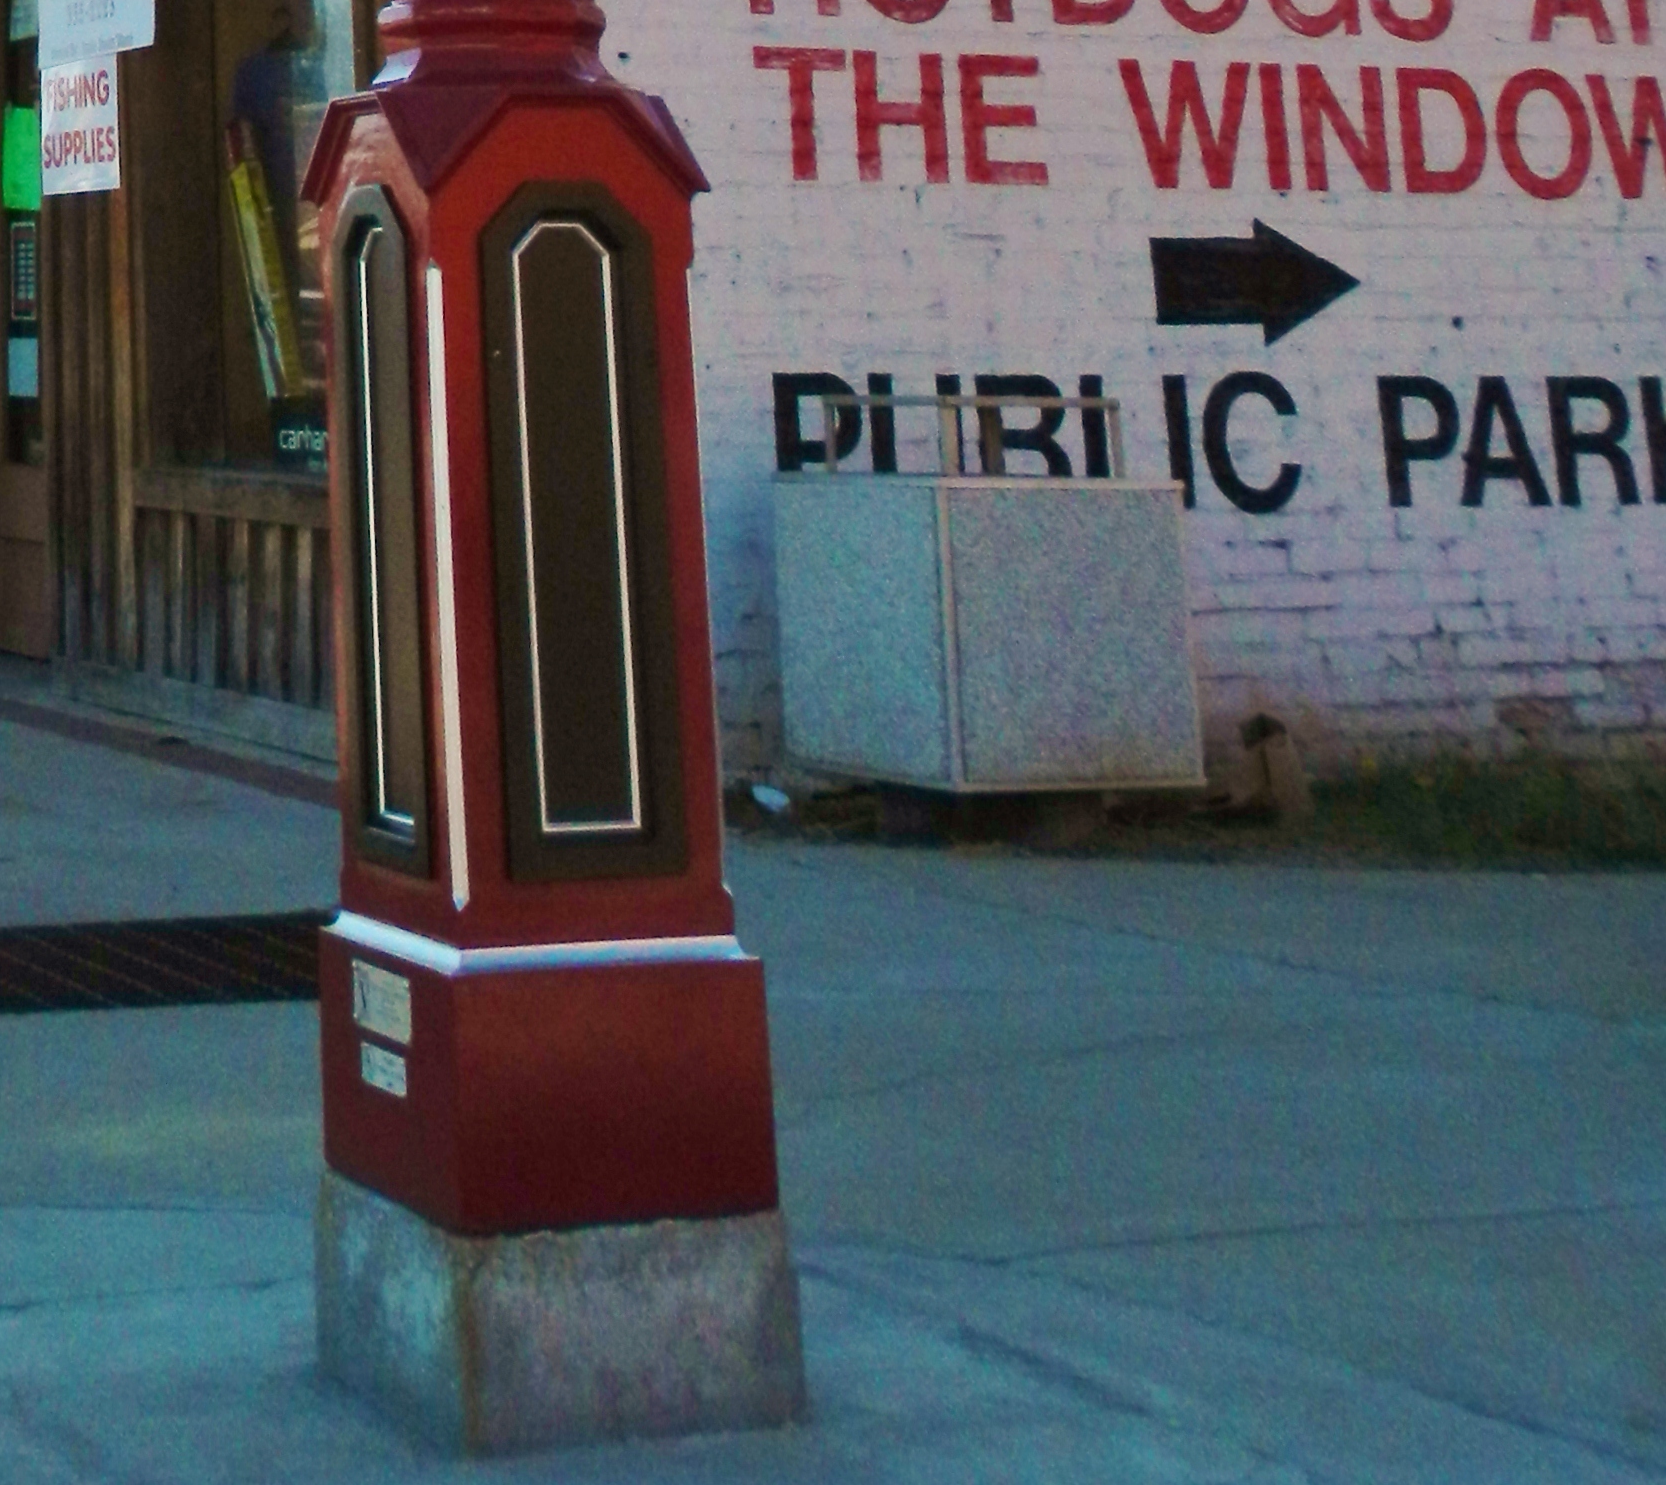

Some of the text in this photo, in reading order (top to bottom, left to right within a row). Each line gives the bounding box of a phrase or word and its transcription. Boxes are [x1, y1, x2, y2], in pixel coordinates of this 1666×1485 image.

[45, 69, 110, 113] FISHING
[752, 45, 1666, 200] THE WINDOW
[42, 126, 116, 169] SUPPLIES
